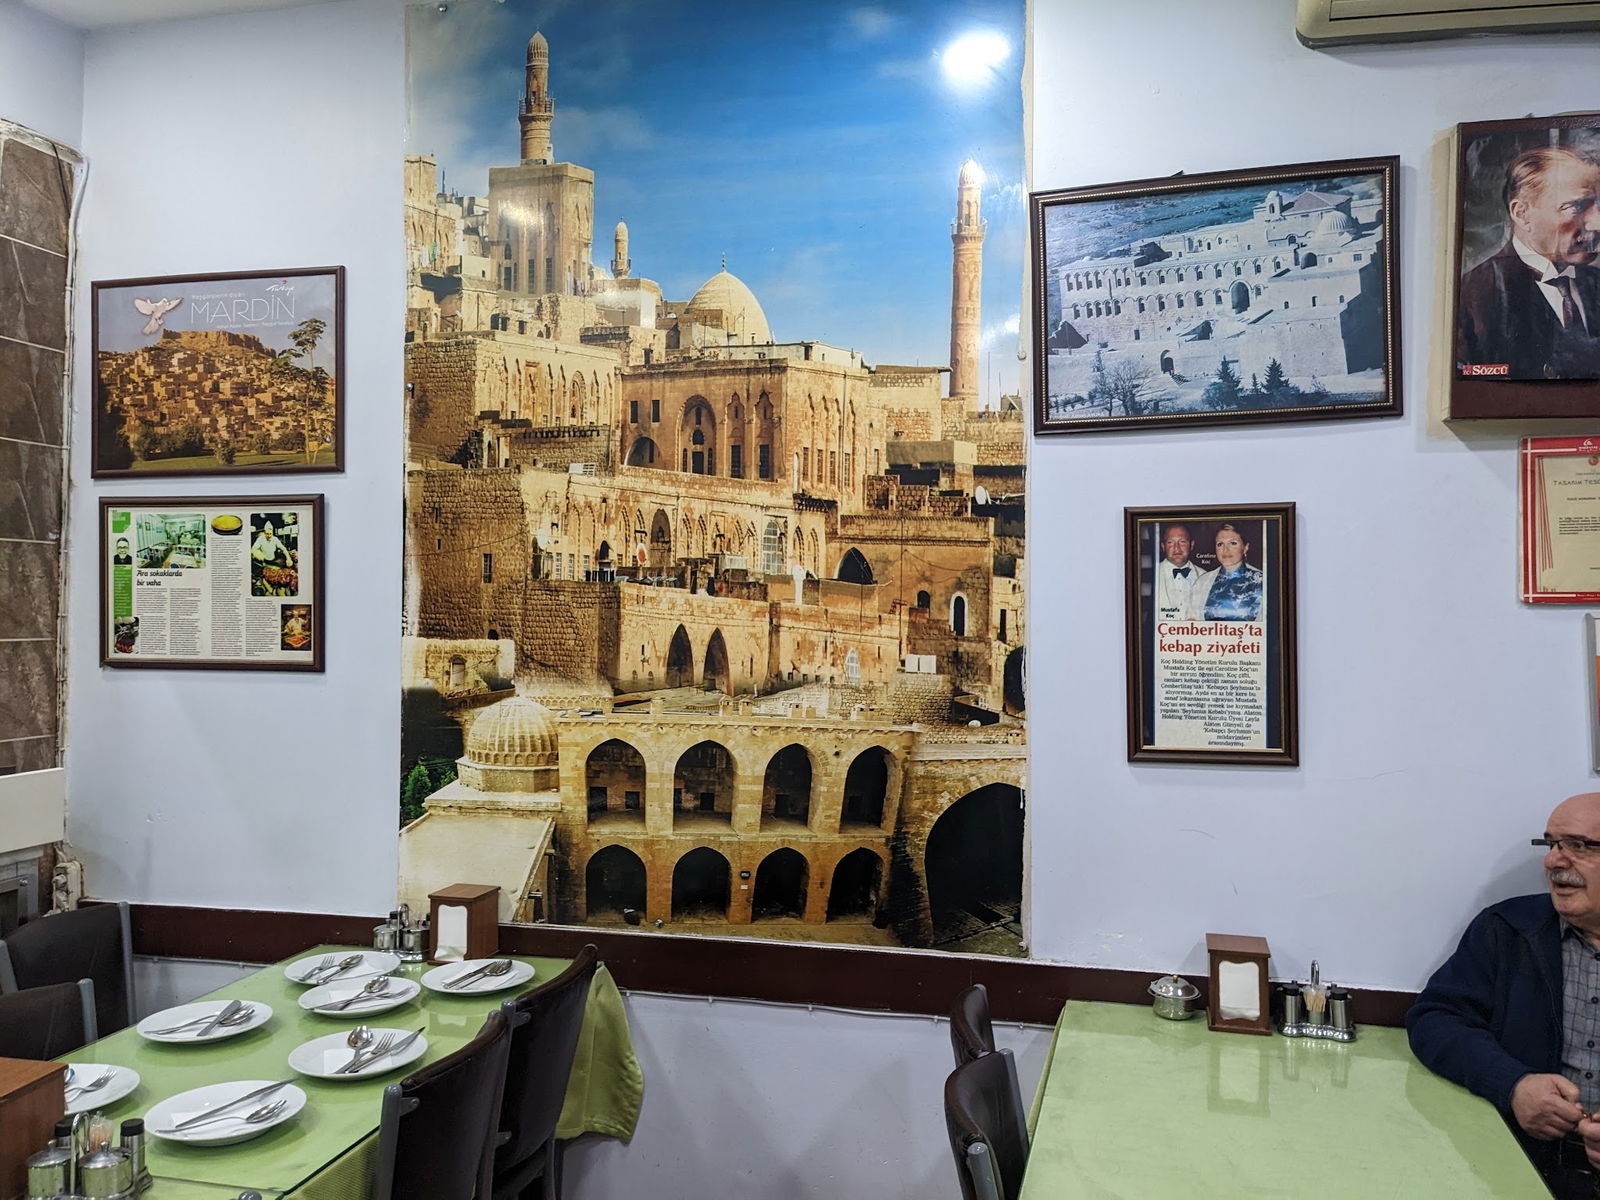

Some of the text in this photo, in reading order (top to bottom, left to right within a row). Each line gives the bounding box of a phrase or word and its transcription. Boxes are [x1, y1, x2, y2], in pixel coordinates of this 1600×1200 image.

[191, 295, 295, 324] MARDİN
[1158, 622, 1262, 639] Çemberlitaş'ta
[1160, 640, 1260, 657] kebap ziyafeti
